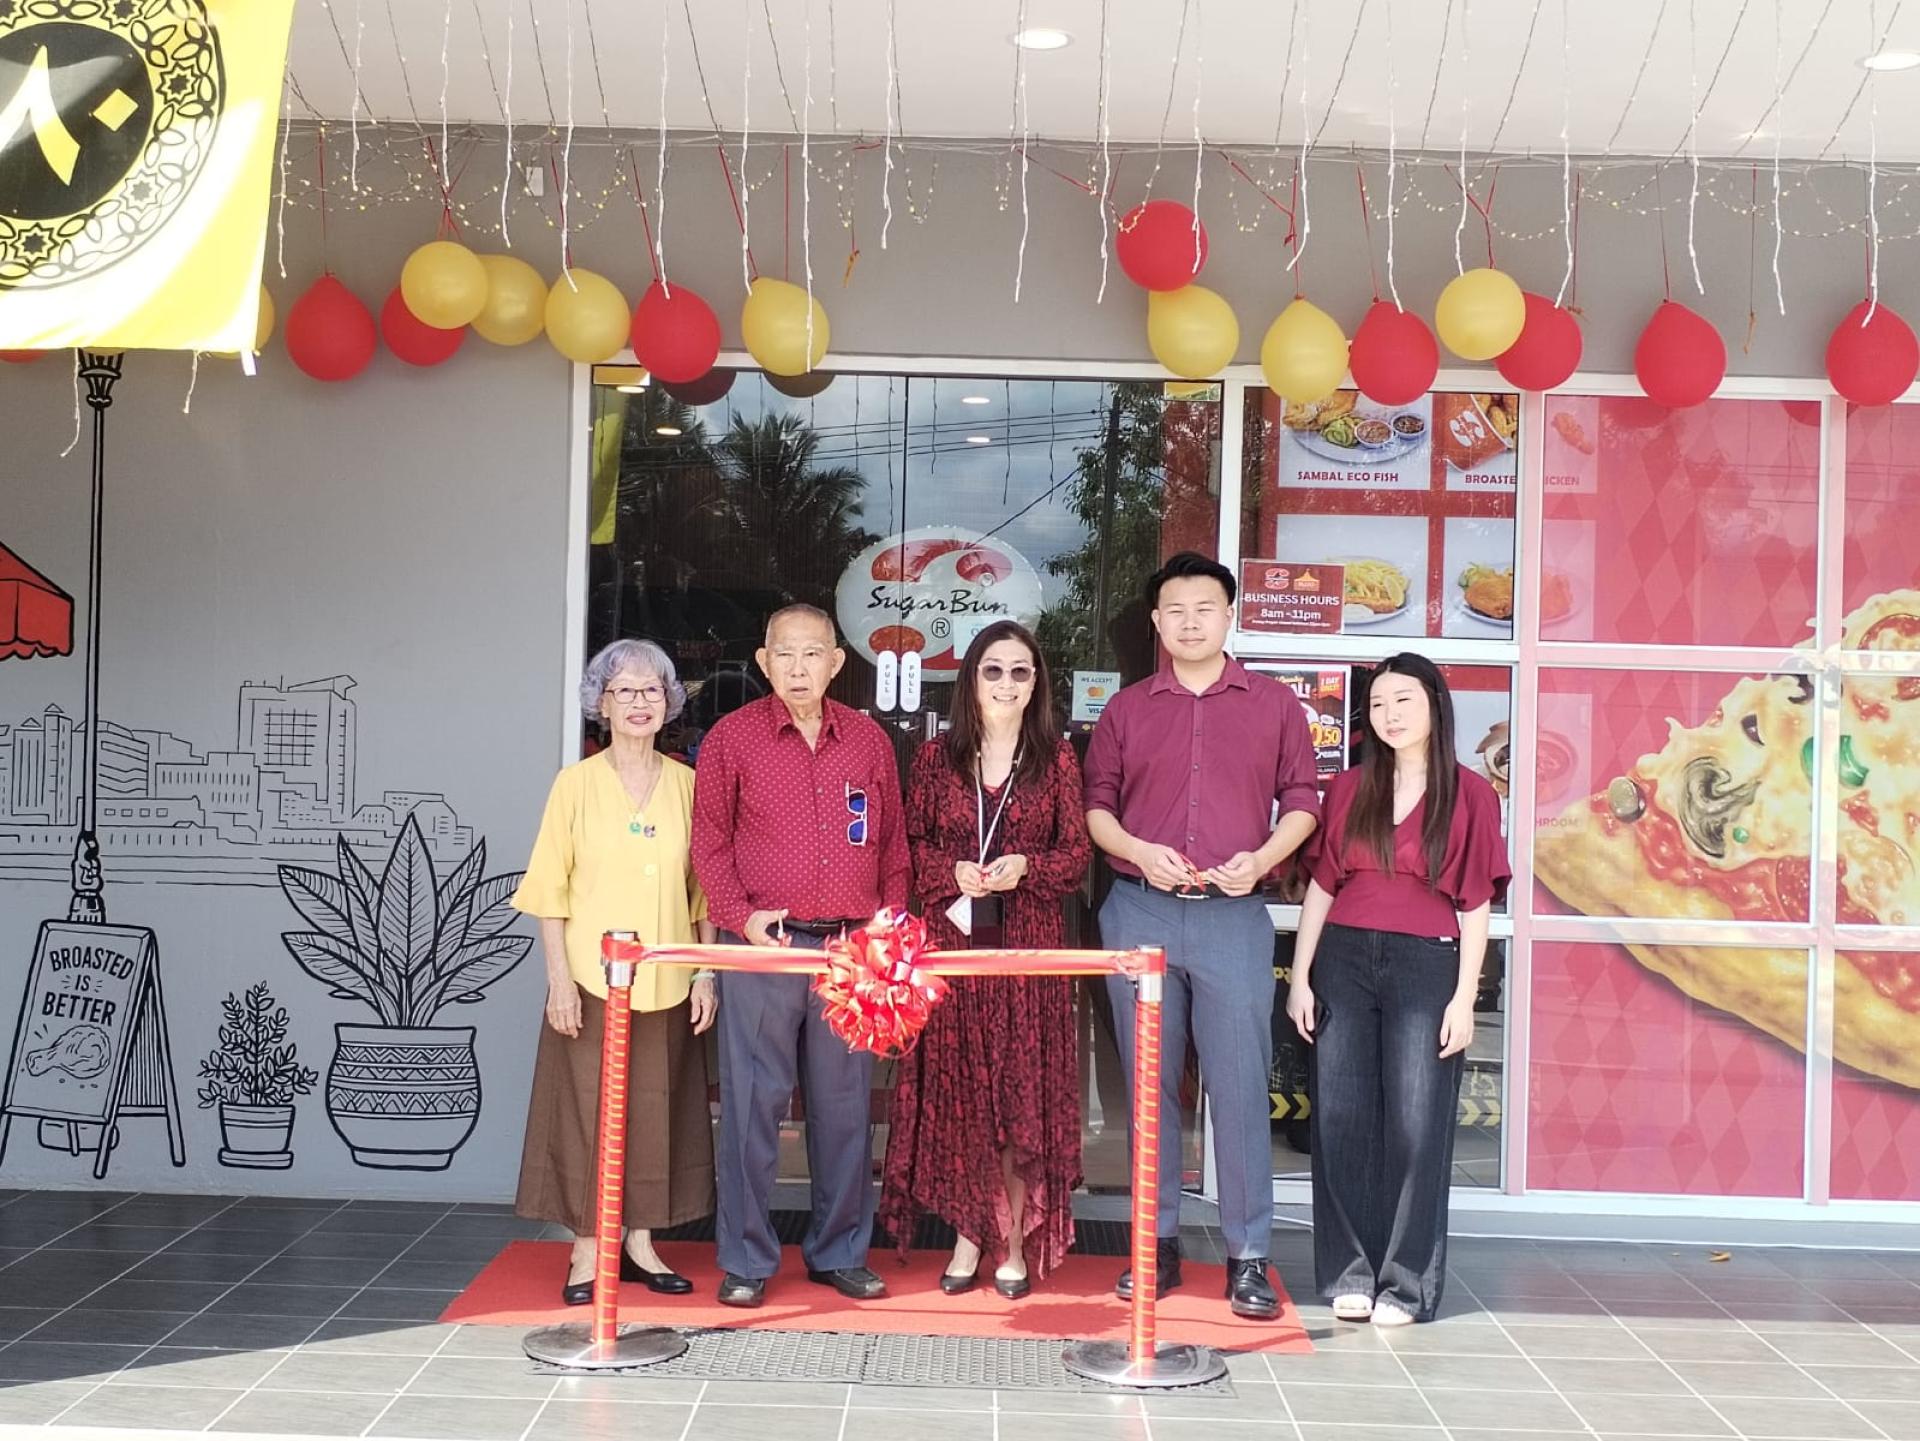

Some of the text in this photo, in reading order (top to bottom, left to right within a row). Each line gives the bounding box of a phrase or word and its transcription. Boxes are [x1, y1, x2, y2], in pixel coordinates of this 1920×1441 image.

[1297, 471, 1399, 482] SAMBAL ECO FISH
[1244, 592, 1340, 606] BUSINESS HOURS
[1261, 608, 1284, 618] 8am
[884, 663, 892, 693] PULL
[50, 946, 134, 980] BROASTED
[75, 974, 91, 992] IS
[42, 991, 116, 1027] BETTER
